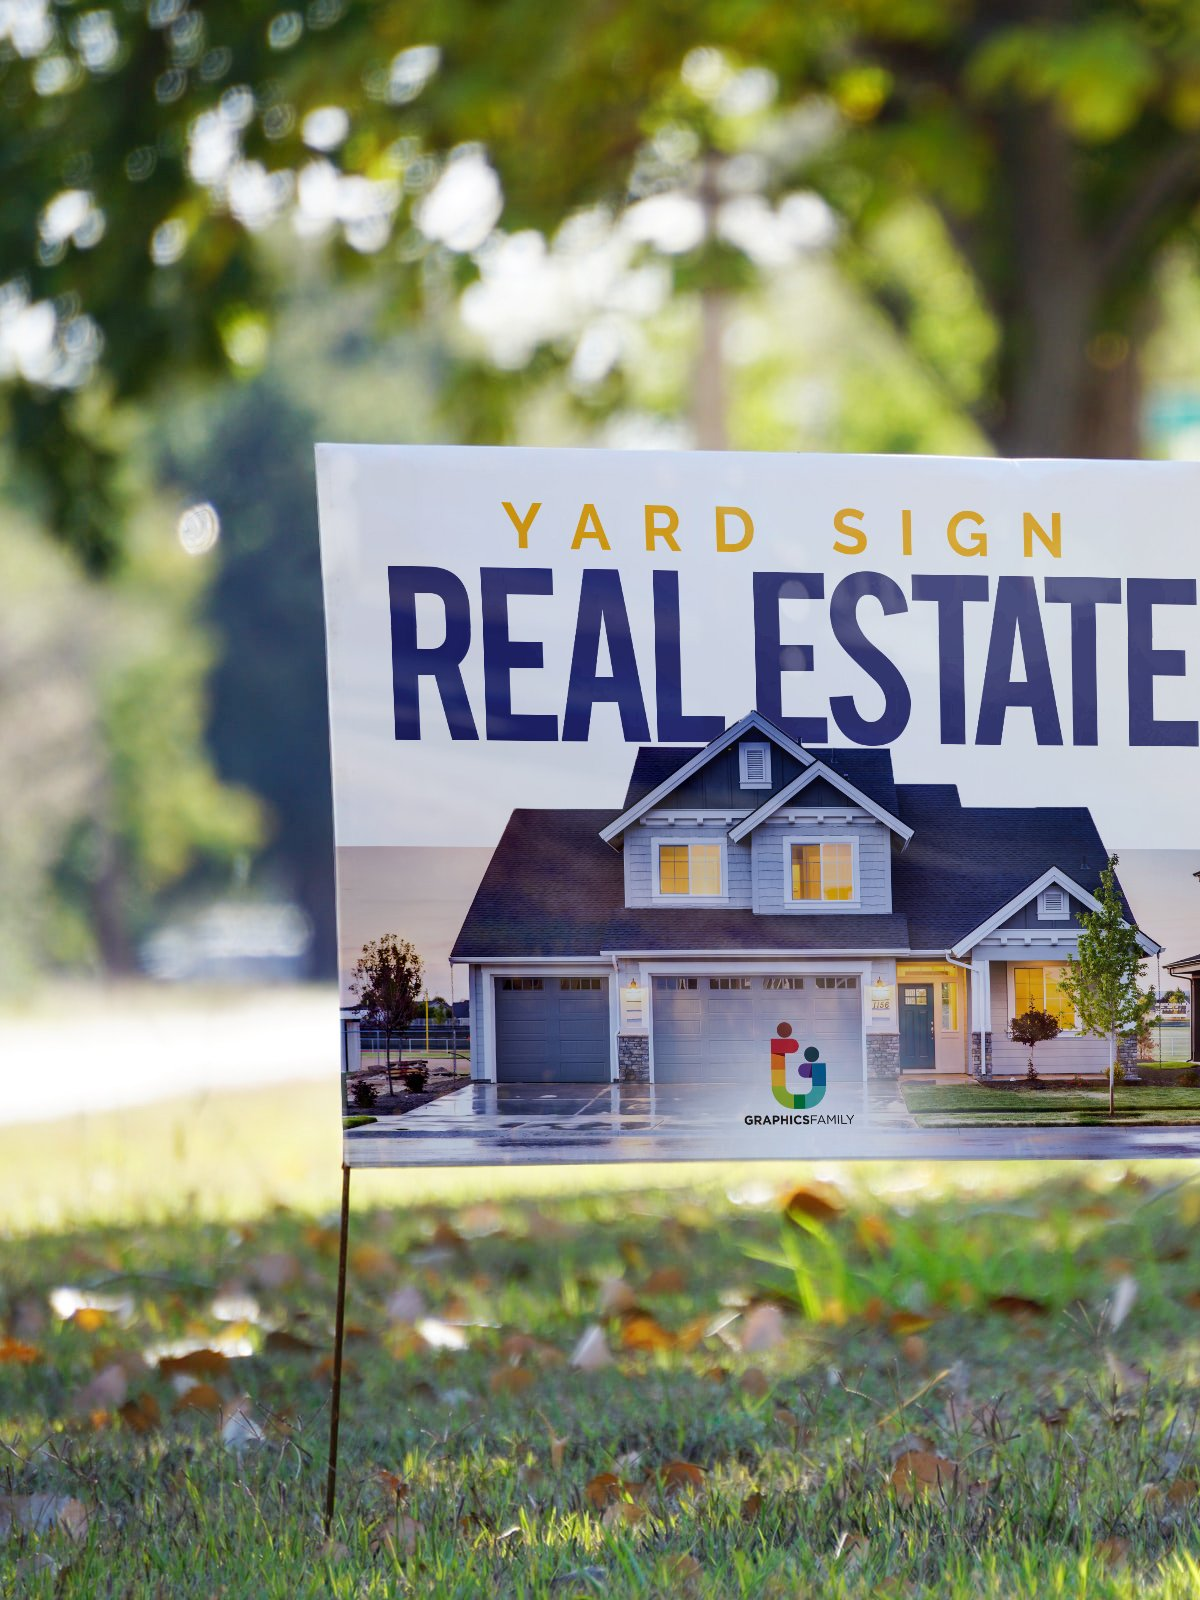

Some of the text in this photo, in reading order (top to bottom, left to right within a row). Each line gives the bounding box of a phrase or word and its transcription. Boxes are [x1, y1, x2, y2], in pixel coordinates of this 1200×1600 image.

[502, 502, 1062, 559] YARD SIGN
[388, 566, 1200, 748] REAL ESTATE
[744, 1114, 855, 1126] GRAPHICSFAMILY
